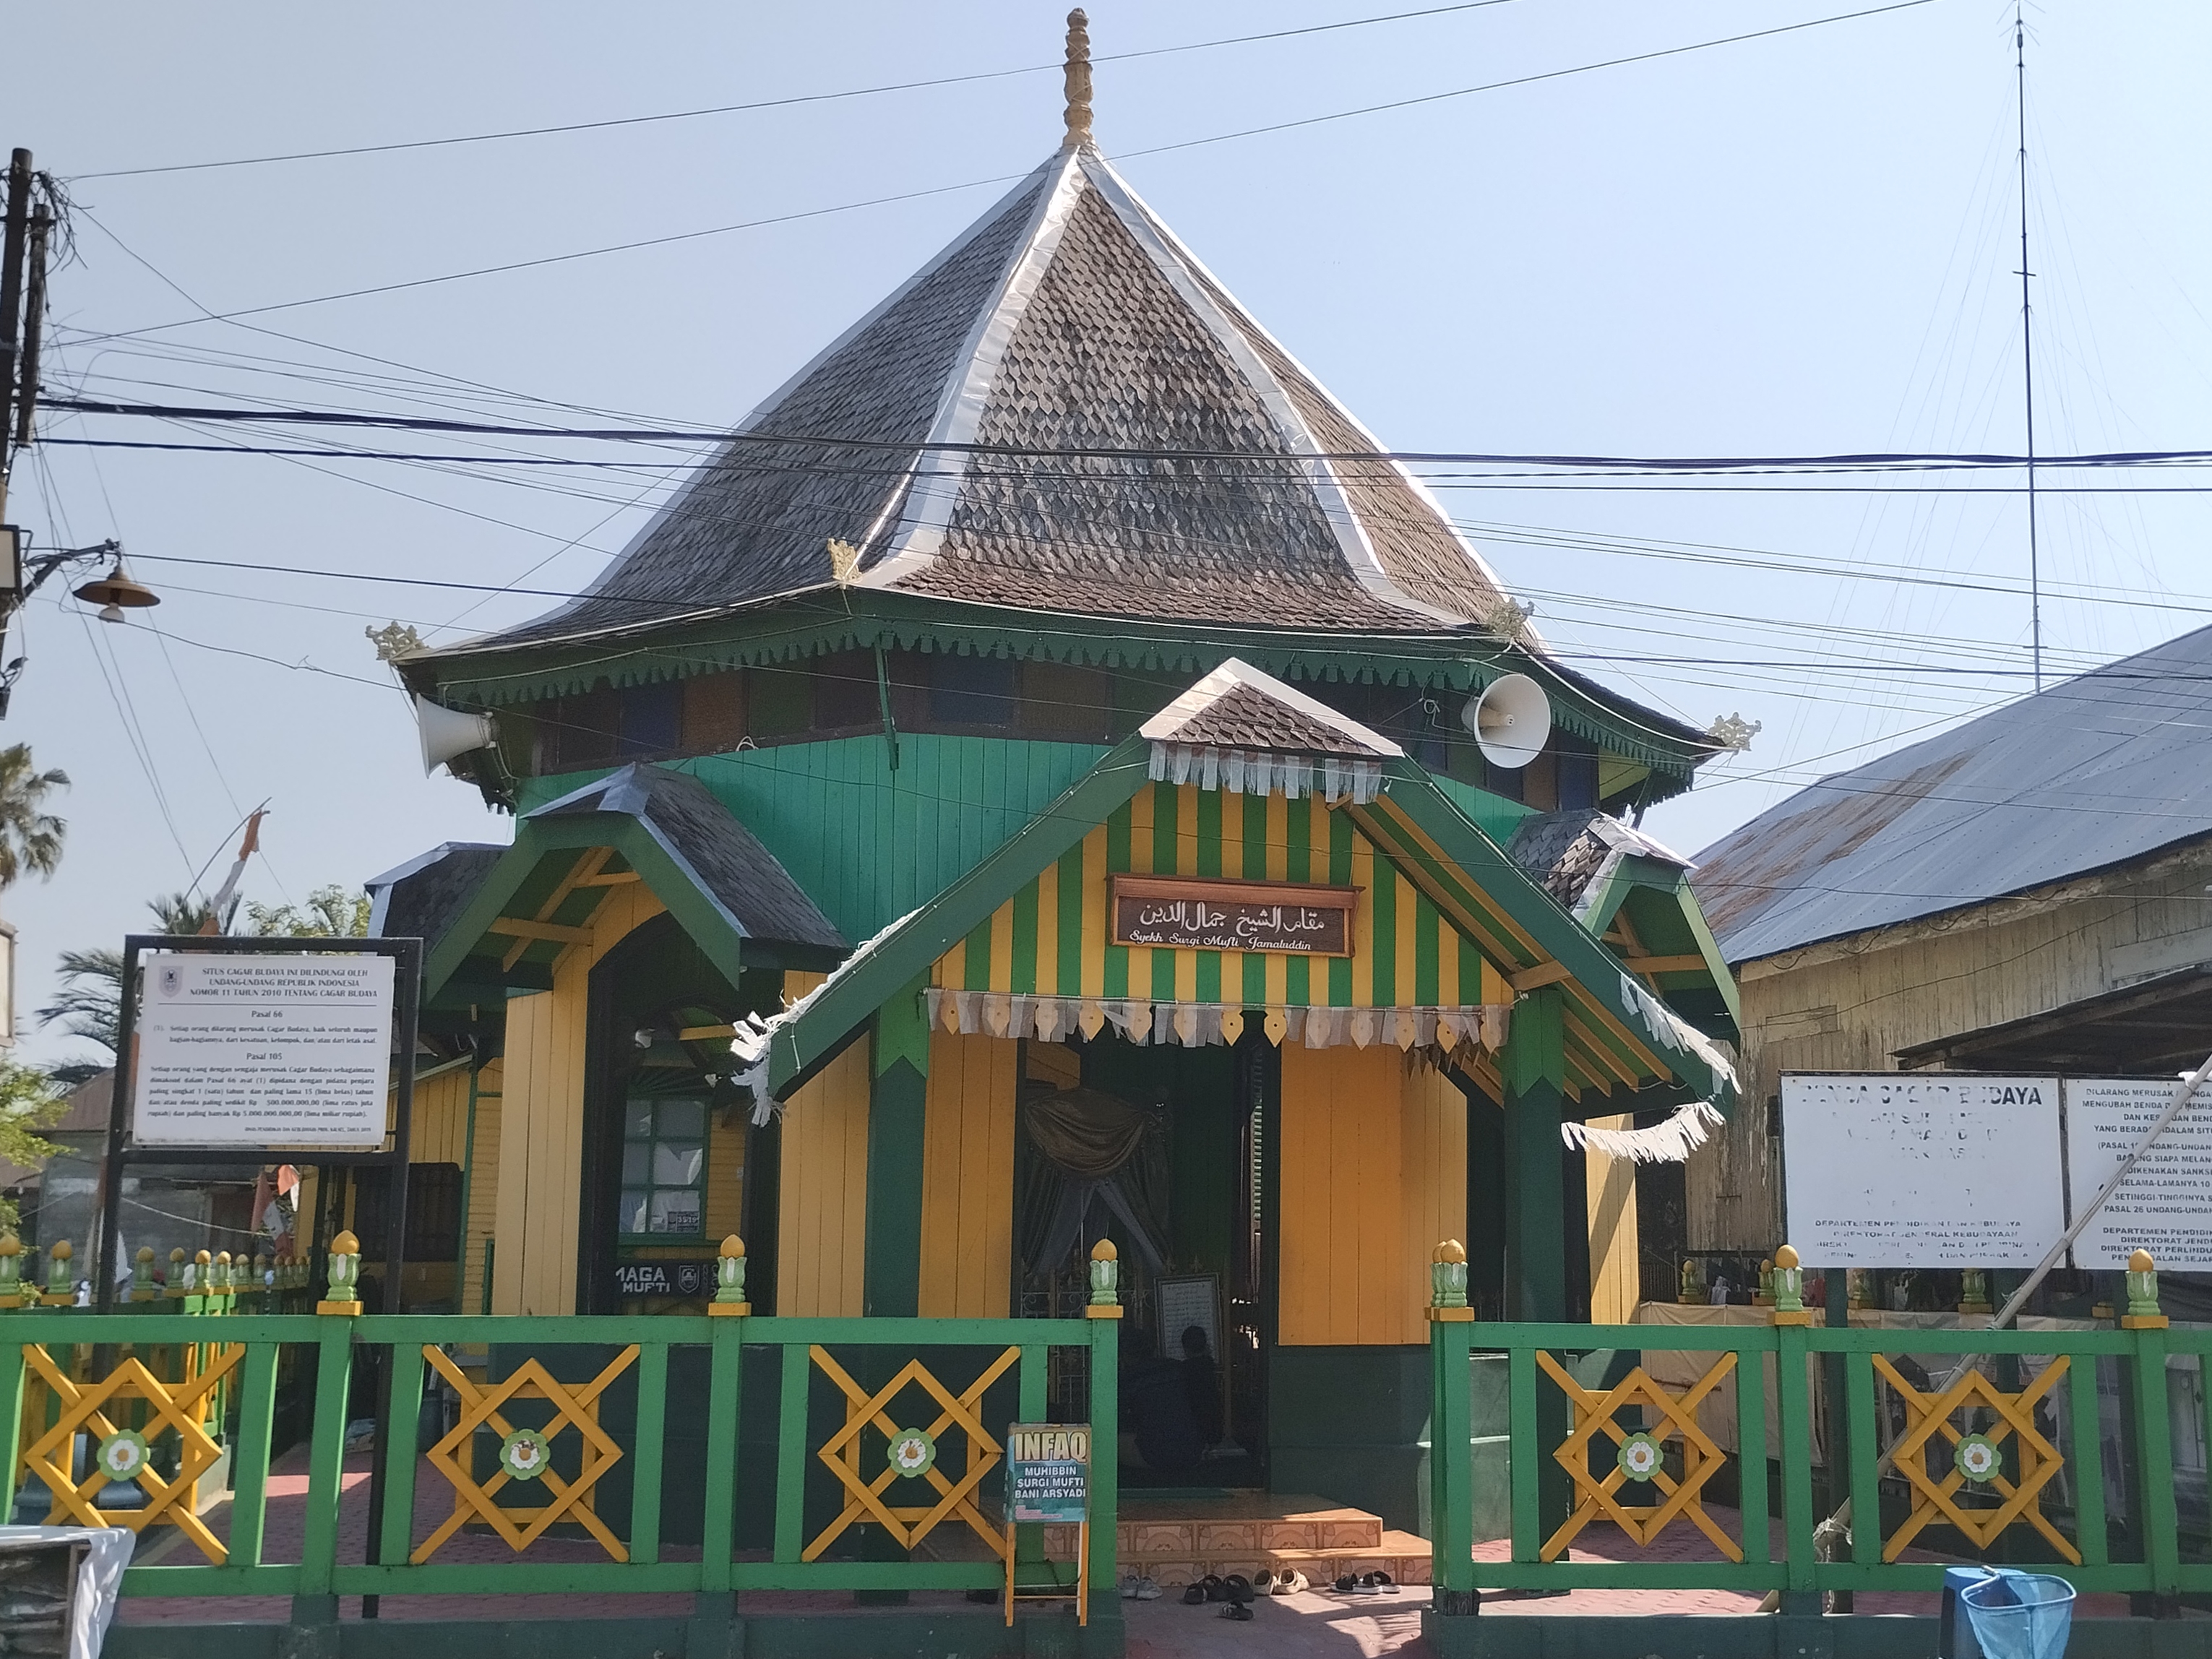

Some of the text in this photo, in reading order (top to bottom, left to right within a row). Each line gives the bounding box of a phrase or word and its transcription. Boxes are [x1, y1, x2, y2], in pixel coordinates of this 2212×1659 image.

[1140, 900, 1325, 937] مقام الشيخ جمال الدين
[1129, 930, 1312, 951] Syekh Surgi Mufti Jamaluddin
[2132, 1089, 2174, 1098] MERUSAK
[2120, 1125, 2152, 1134] BERAD
[2120, 1178, 2198, 1187] SELAMA-LAMANYA
[2114, 1193, 2205, 1202] SETINGGI-TINGGINYA
[623, 1282, 670, 1293] MUFTI
[1015, 1431, 1087, 1463] INFAQ
[1025, 1466, 1077, 1476] MUHIBBIN
[1017, 1478, 1083, 1488] SURGI MUFTI
[1015, 1488, 1086, 1499] BANI ARSYADI
